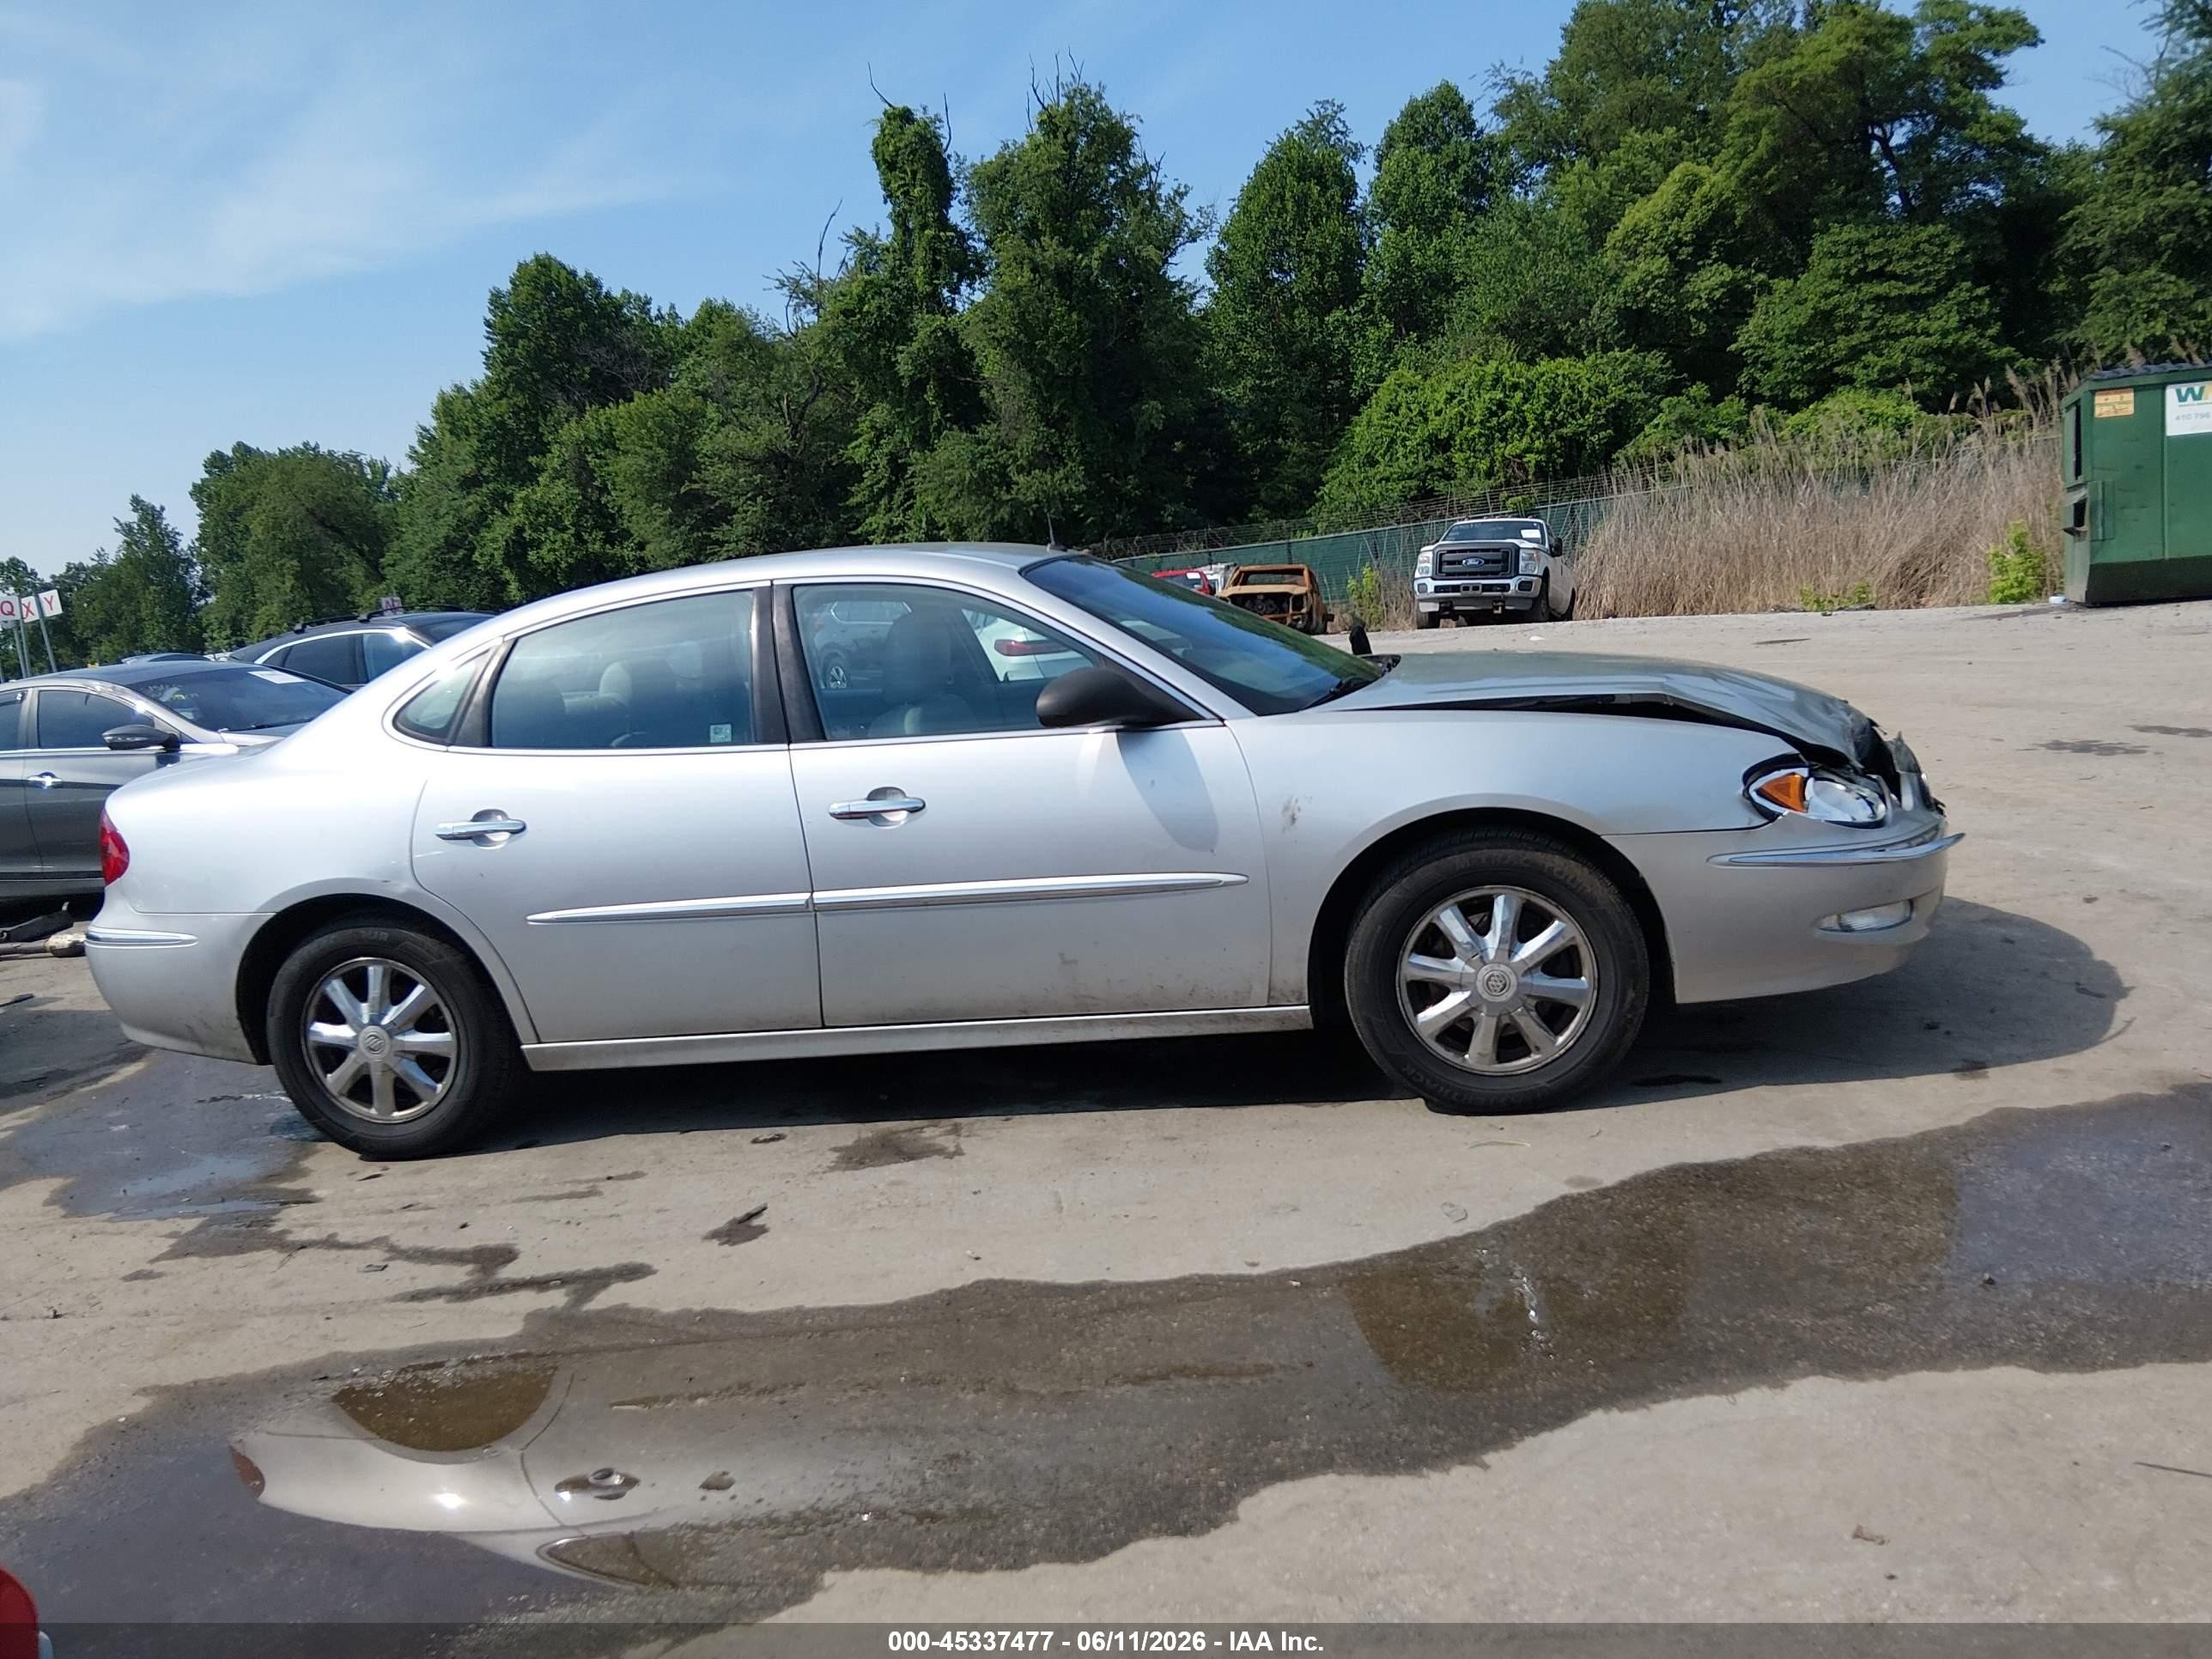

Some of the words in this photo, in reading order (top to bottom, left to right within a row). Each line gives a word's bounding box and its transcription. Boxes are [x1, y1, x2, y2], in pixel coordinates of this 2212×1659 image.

[0, 600, 15, 617] Q
[21, 601, 35, 619] X
[44, 595, 53, 611] Y
